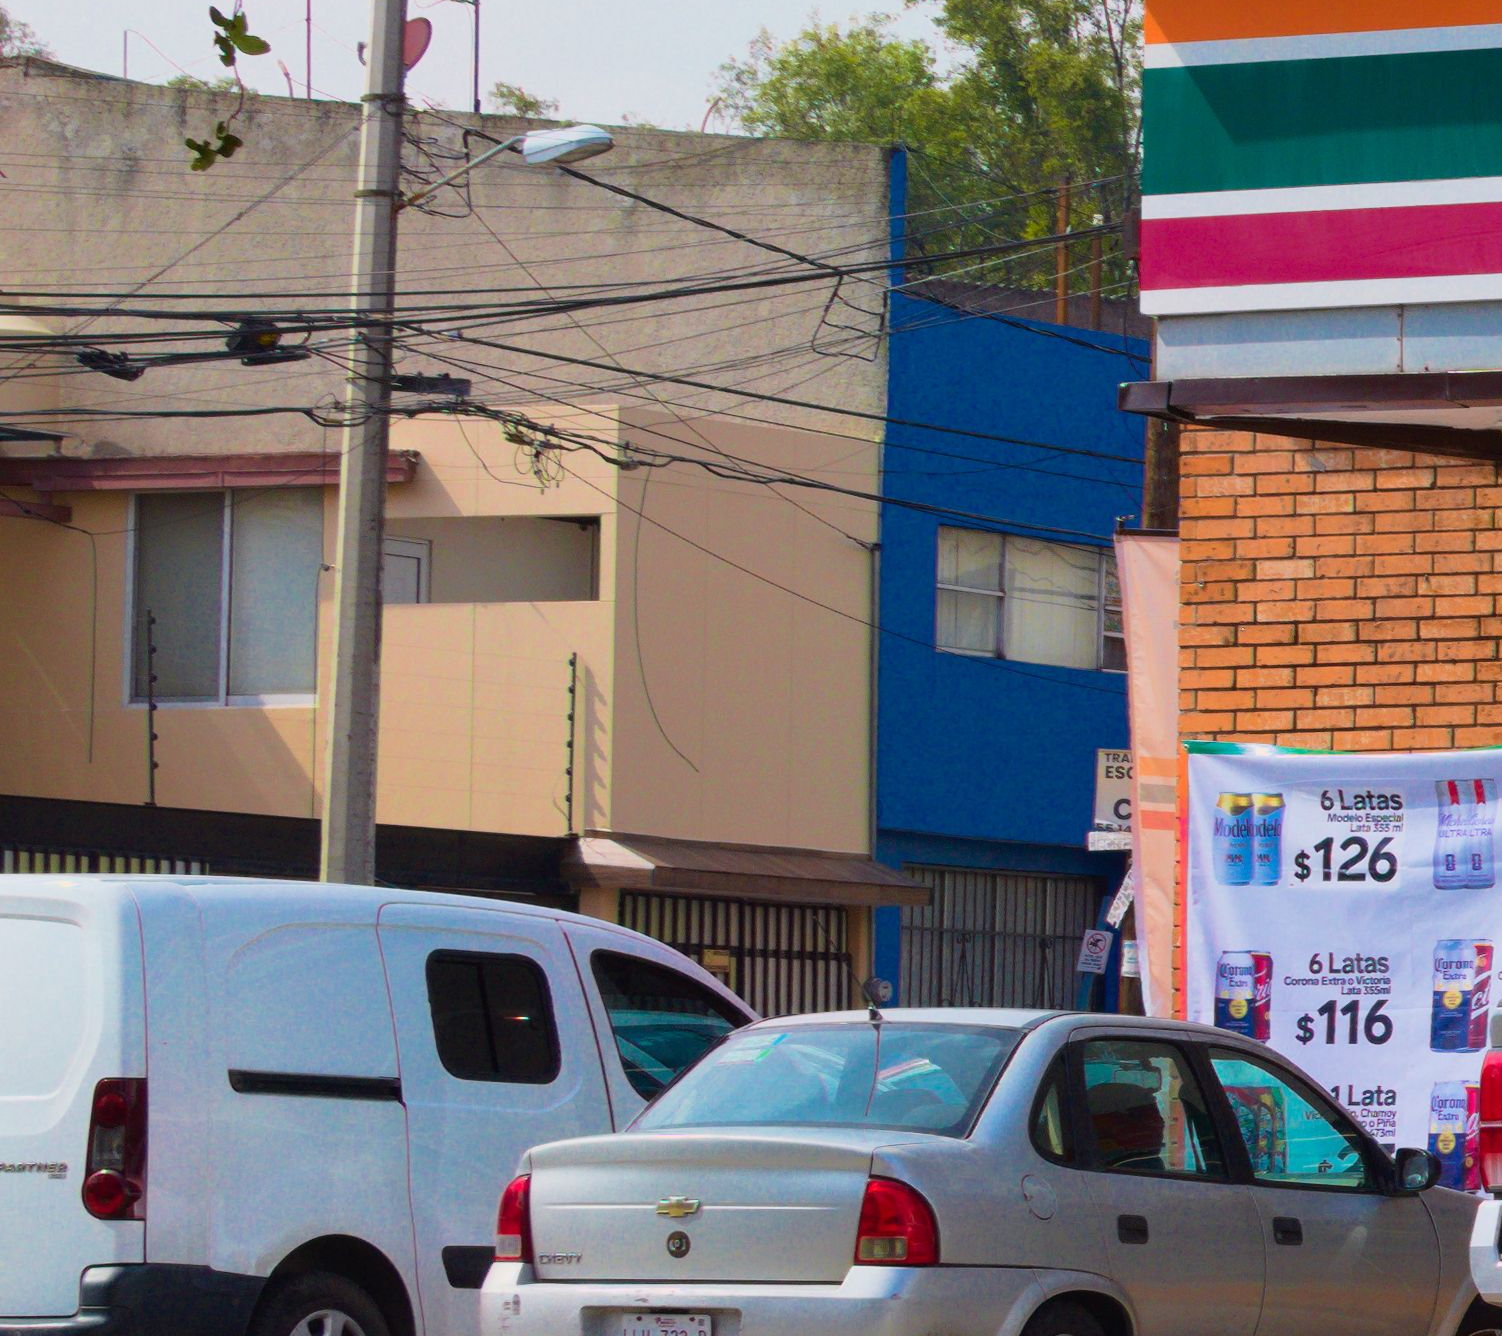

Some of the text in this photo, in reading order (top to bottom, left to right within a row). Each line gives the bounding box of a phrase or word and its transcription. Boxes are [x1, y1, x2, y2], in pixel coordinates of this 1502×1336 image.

[1320, 789, 1404, 811] 6 Latas
[1327, 813, 1404, 825] Modelo Especial
[1350, 824, 1372, 832] Lata
[1293, 835, 1398, 883] $126
[1308, 952, 1390, 975] 6 Latas
[1284, 976, 1319, 986] Corona
[1321, 976, 1347, 985] Extra
[1356, 976, 1391, 985] Victoria
[1341, 986, 1391, 995] Lata 355ml
[1295, 999, 1393, 1045] $116
[1347, 1084, 1397, 1107] Lata
[1360, 1109, 1397, 1119] Chamoy
[1376, 1119, 1396, 1128] Piña
